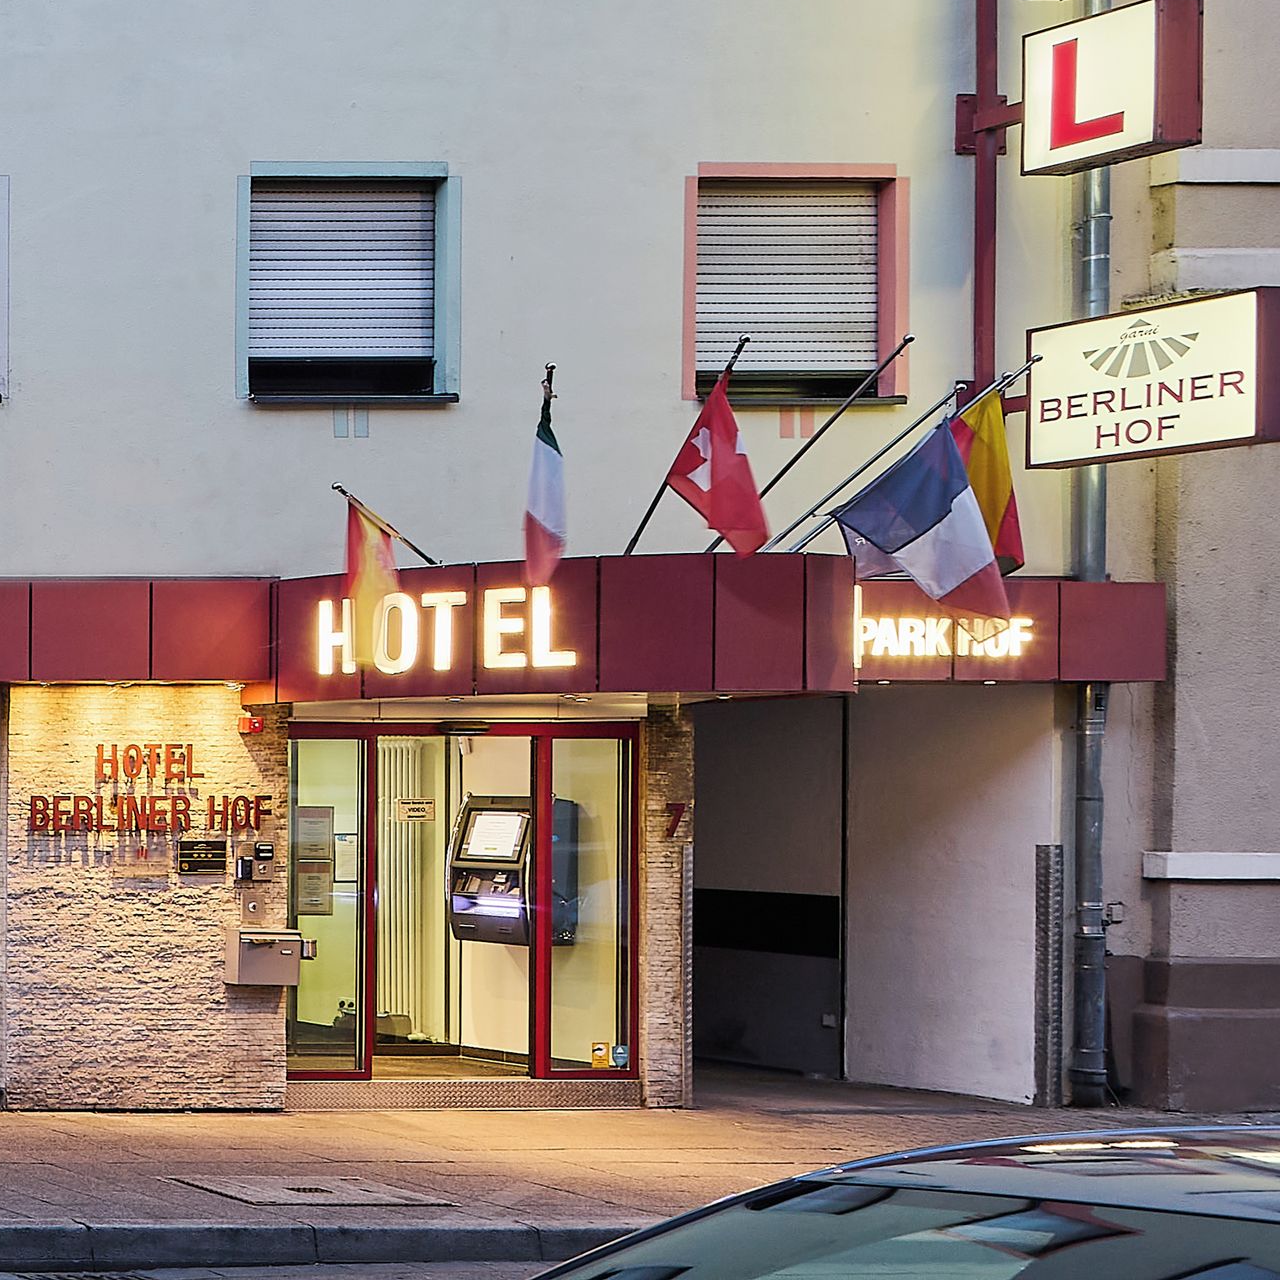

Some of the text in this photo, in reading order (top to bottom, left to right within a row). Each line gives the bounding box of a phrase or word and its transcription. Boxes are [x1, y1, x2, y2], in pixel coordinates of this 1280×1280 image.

[1119, 324, 1160, 345] garni
[1040, 370, 1245, 423] BERLINER
[1095, 414, 1181, 450] HOF
[317, 585, 577, 676] HOTEL
[858, 617, 1034, 657] PARK HOF
[96, 743, 205, 780] HOTEL
[29, 795, 273, 831] BERLINER HOF
[665, 803, 686, 837] 7
